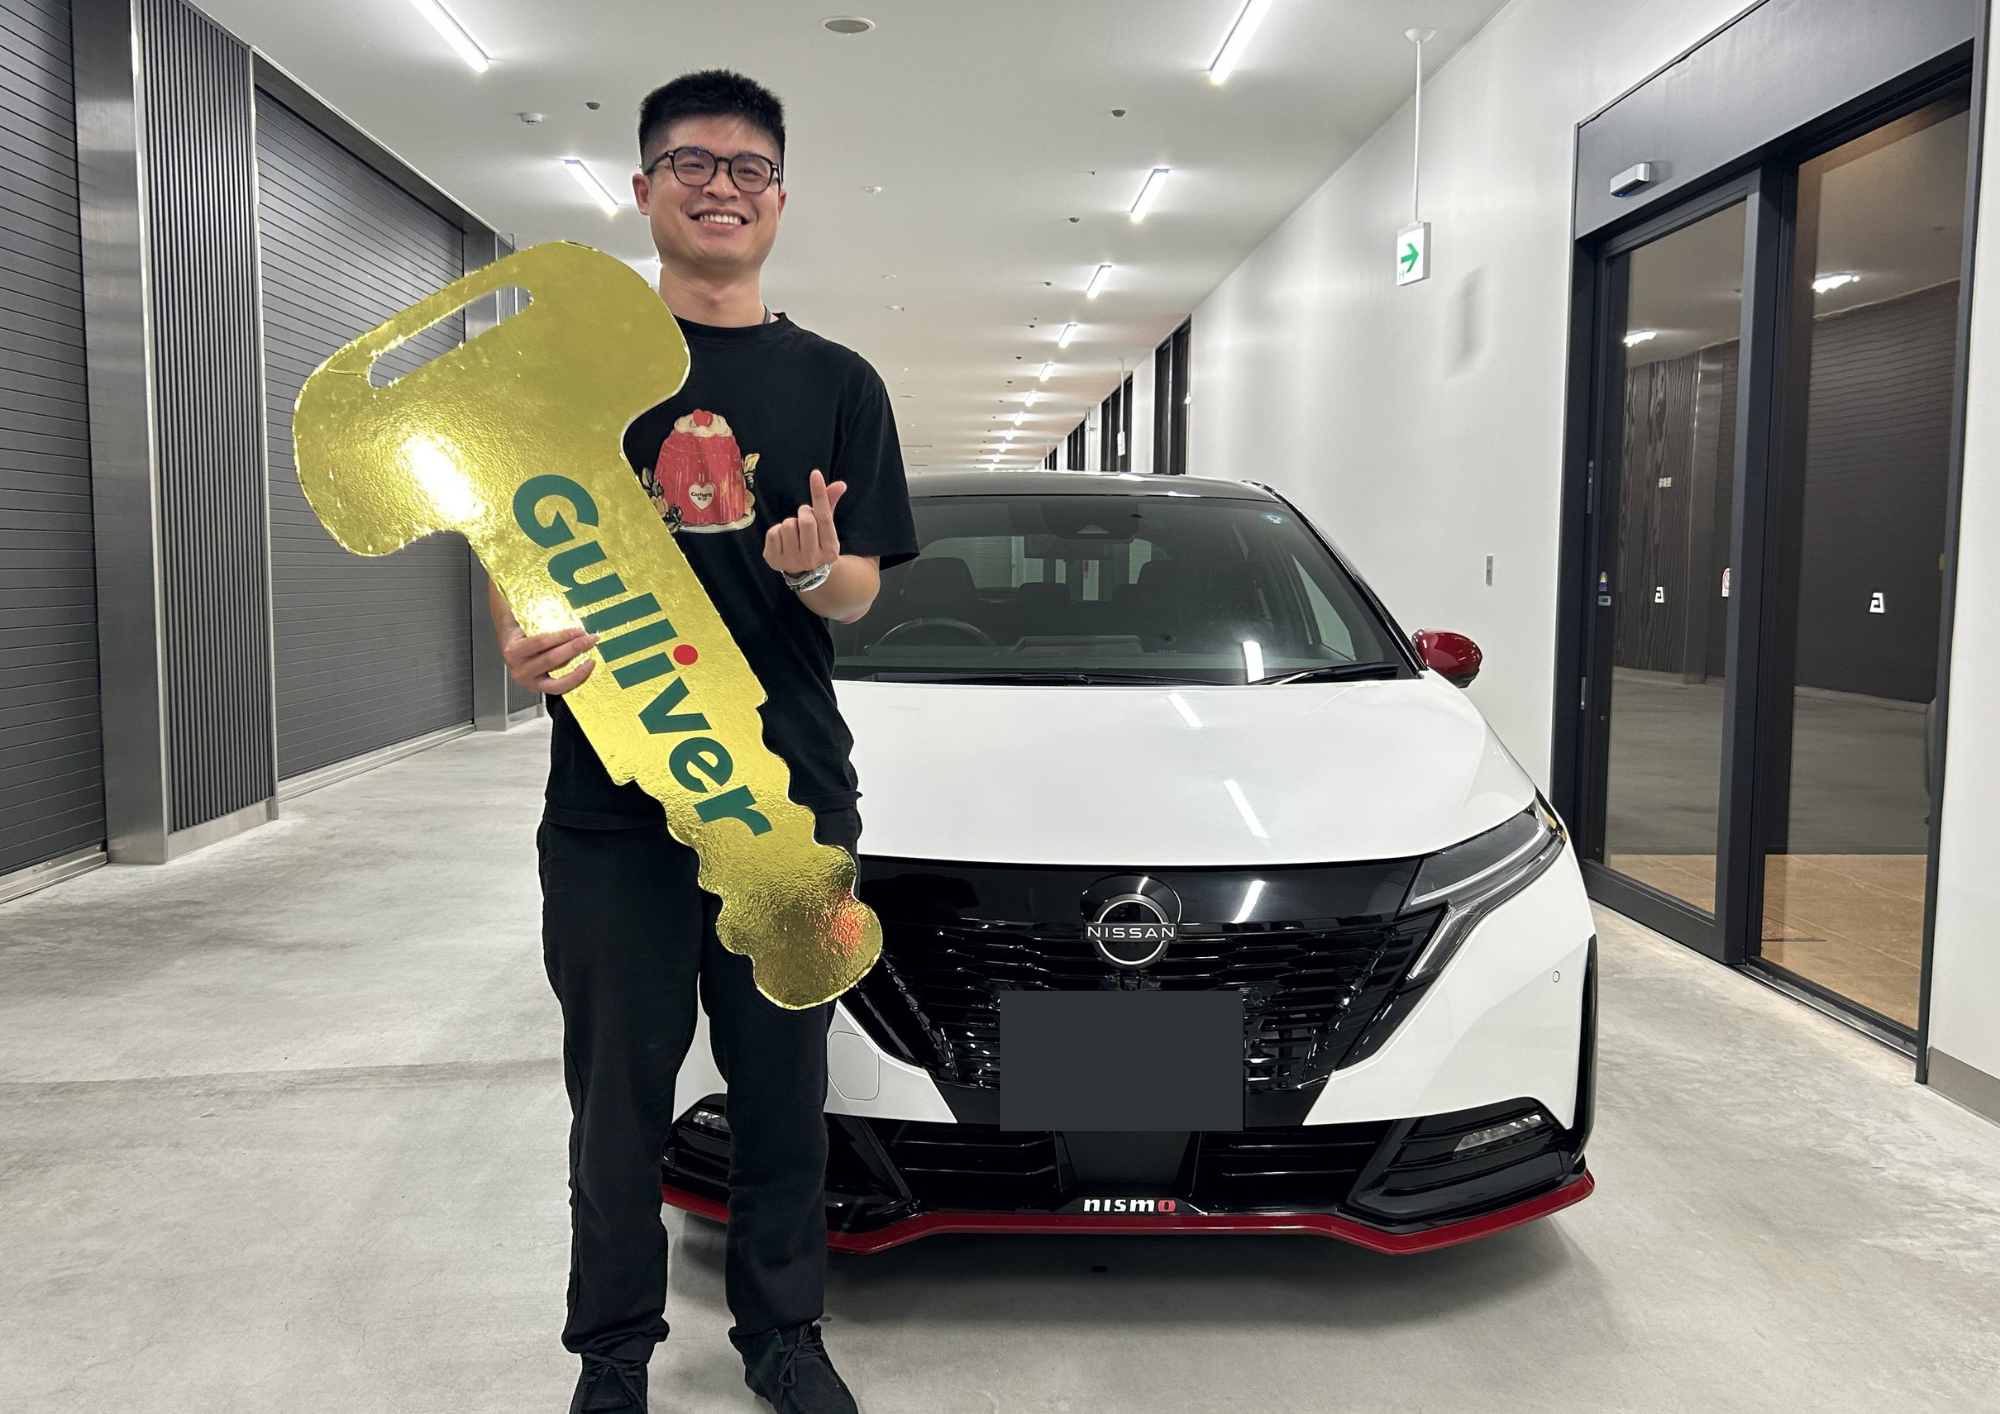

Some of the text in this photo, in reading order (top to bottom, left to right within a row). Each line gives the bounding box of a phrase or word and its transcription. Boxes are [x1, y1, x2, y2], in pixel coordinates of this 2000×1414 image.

[512, 474, 772, 836] Gulliver
[1087, 926, 1175, 939] NISSAN
[1083, 1198, 1176, 1213] nismo
